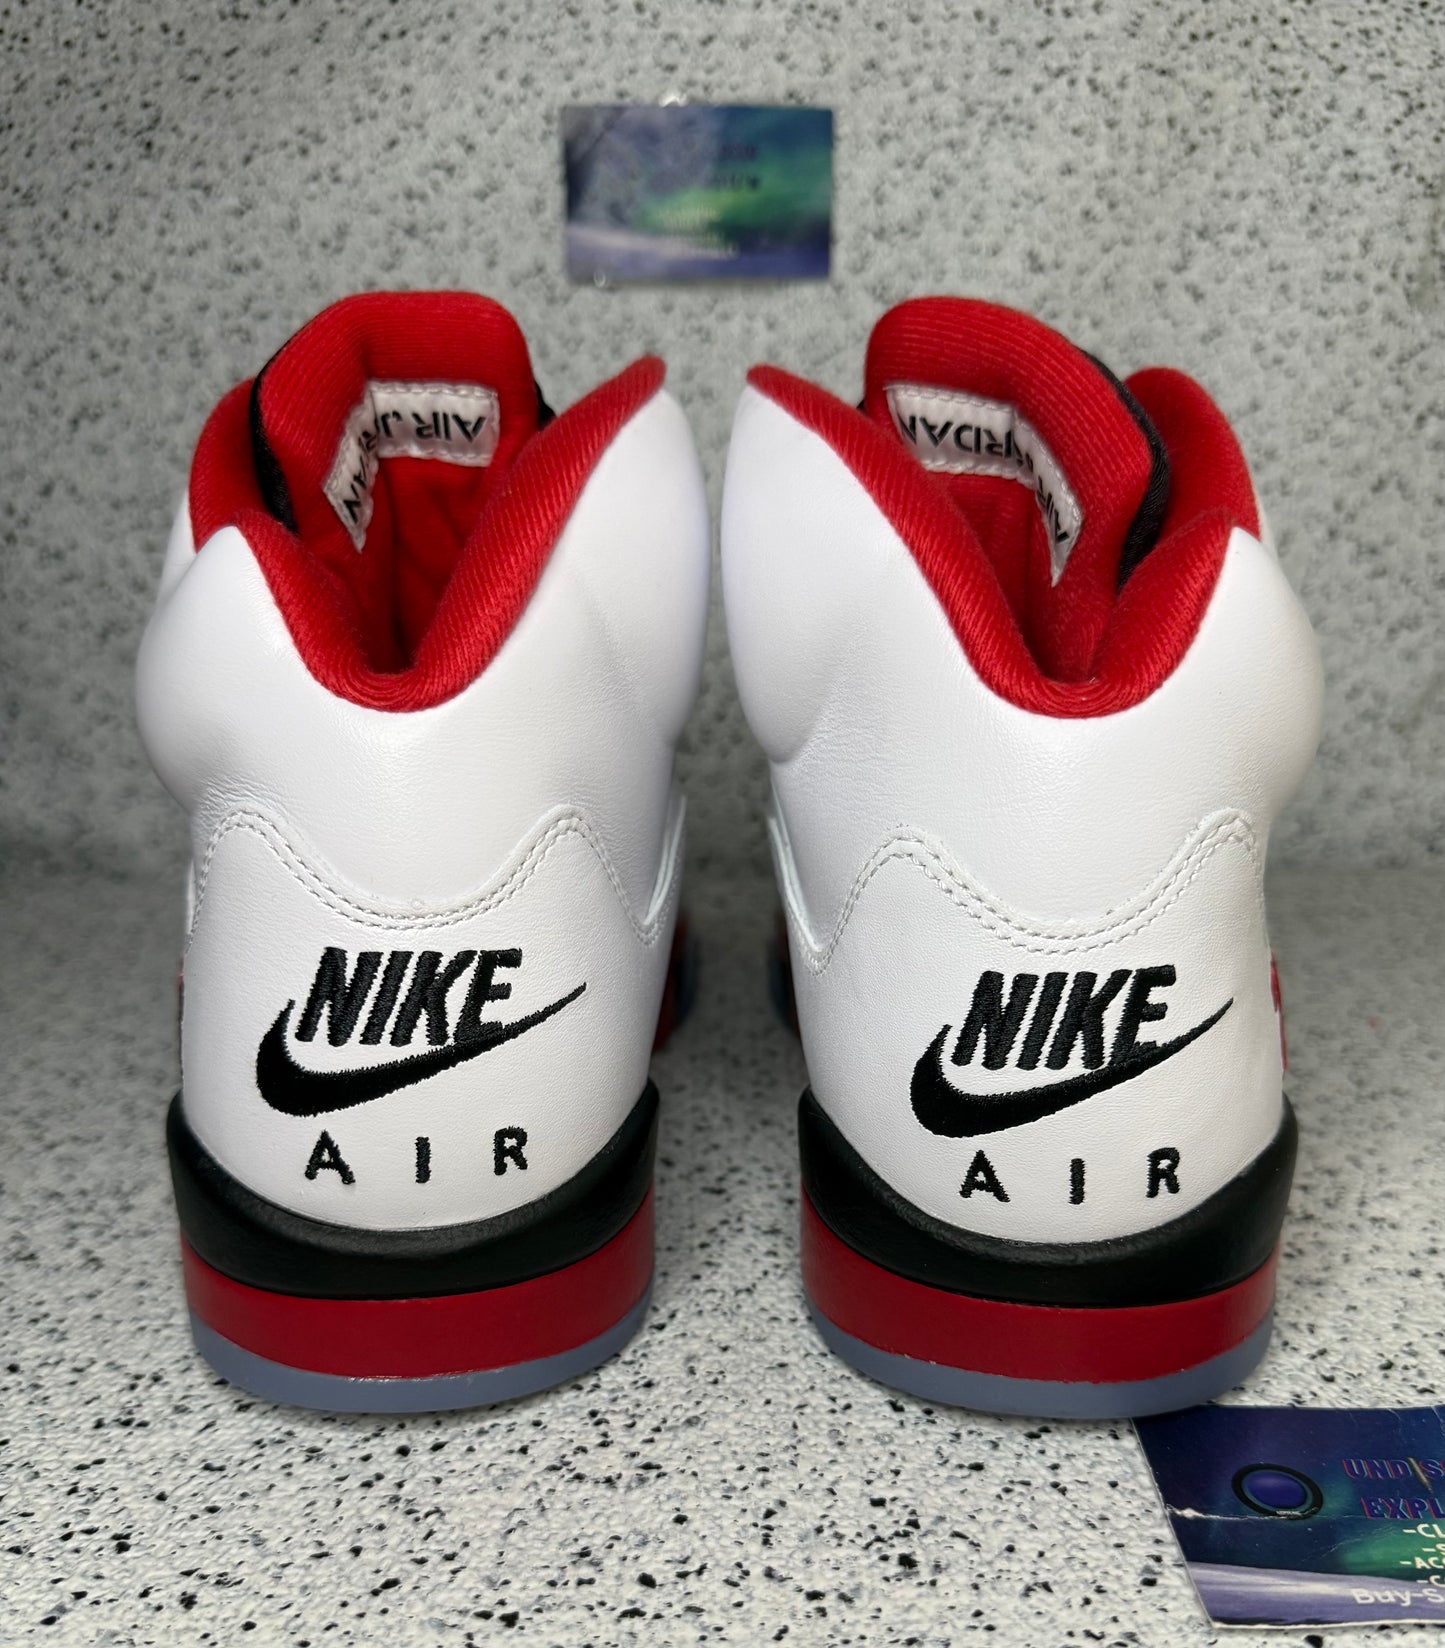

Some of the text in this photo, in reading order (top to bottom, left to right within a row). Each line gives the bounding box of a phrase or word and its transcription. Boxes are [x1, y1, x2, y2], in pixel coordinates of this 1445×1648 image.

[412, 411, 487, 443] AIR
[295, 946, 523, 1047] NIKE
[951, 964, 1177, 1071] NIKE
[304, 1125, 529, 1185] AIR
[958, 1147, 1181, 1205] AIR
[1399, 1556, 1445, 1569] -AC
